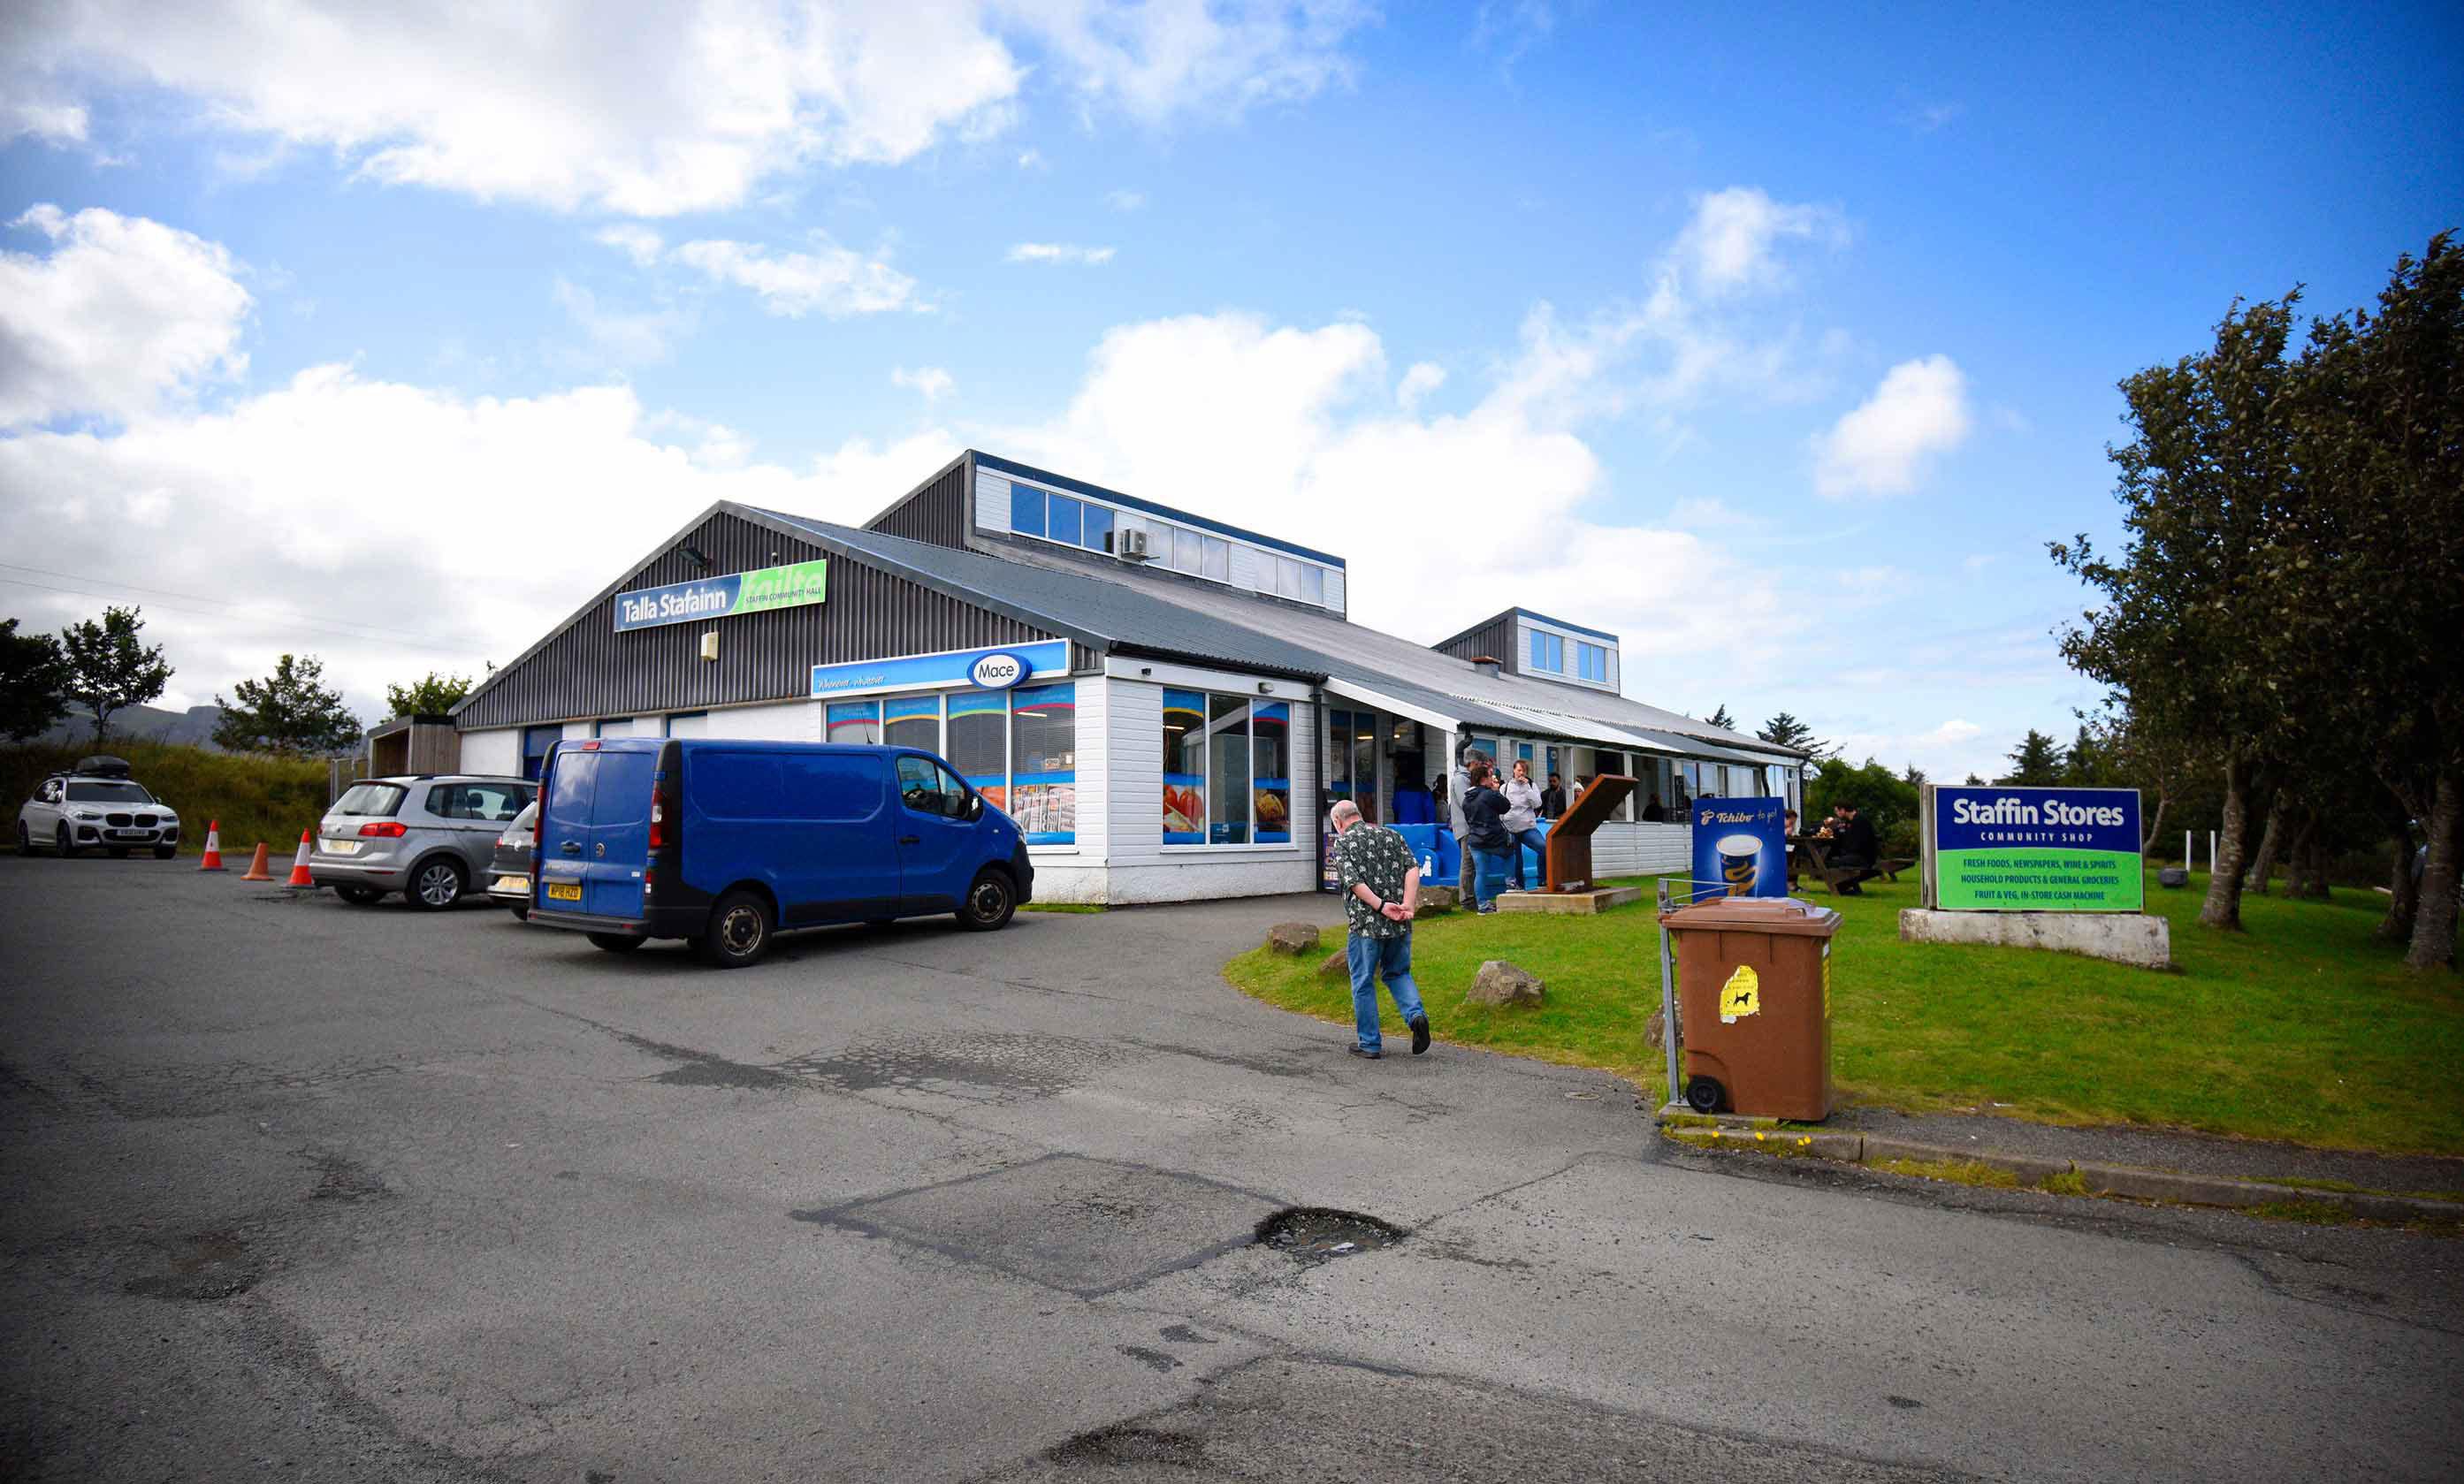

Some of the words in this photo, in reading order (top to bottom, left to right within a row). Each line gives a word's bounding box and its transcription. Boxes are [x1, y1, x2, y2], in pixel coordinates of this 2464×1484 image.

[769, 590, 805, 601] COMMUNITY
[622, 597, 657, 623] Talla
[660, 587, 727, 618] Stafainn
[978, 664, 1015, 679] Mace
[1716, 812, 1754, 823] Tchibo
[1757, 809, 1766, 820] to
[1953, 797, 2039, 826] Staffin
[2043, 799, 2125, 826] Stores
[1980, 832, 2054, 841] COMMUNITY
[1987, 859, 2011, 868] FOODS,
[2014, 859, 2062, 870] NEWSPAPERS,
[1961, 875, 2003, 884] HOUSEHOLD
[2005, 875, 2041, 884] PRODUCTS
[2082, 876, 2119, 885] GROCERIES
[1975, 890, 1995, 899] FRUIT
[1997, 890, 2002, 899] &
[2003, 890, 2019, 900] VEG,
[2021, 890, 2052, 899] IN-STORE
